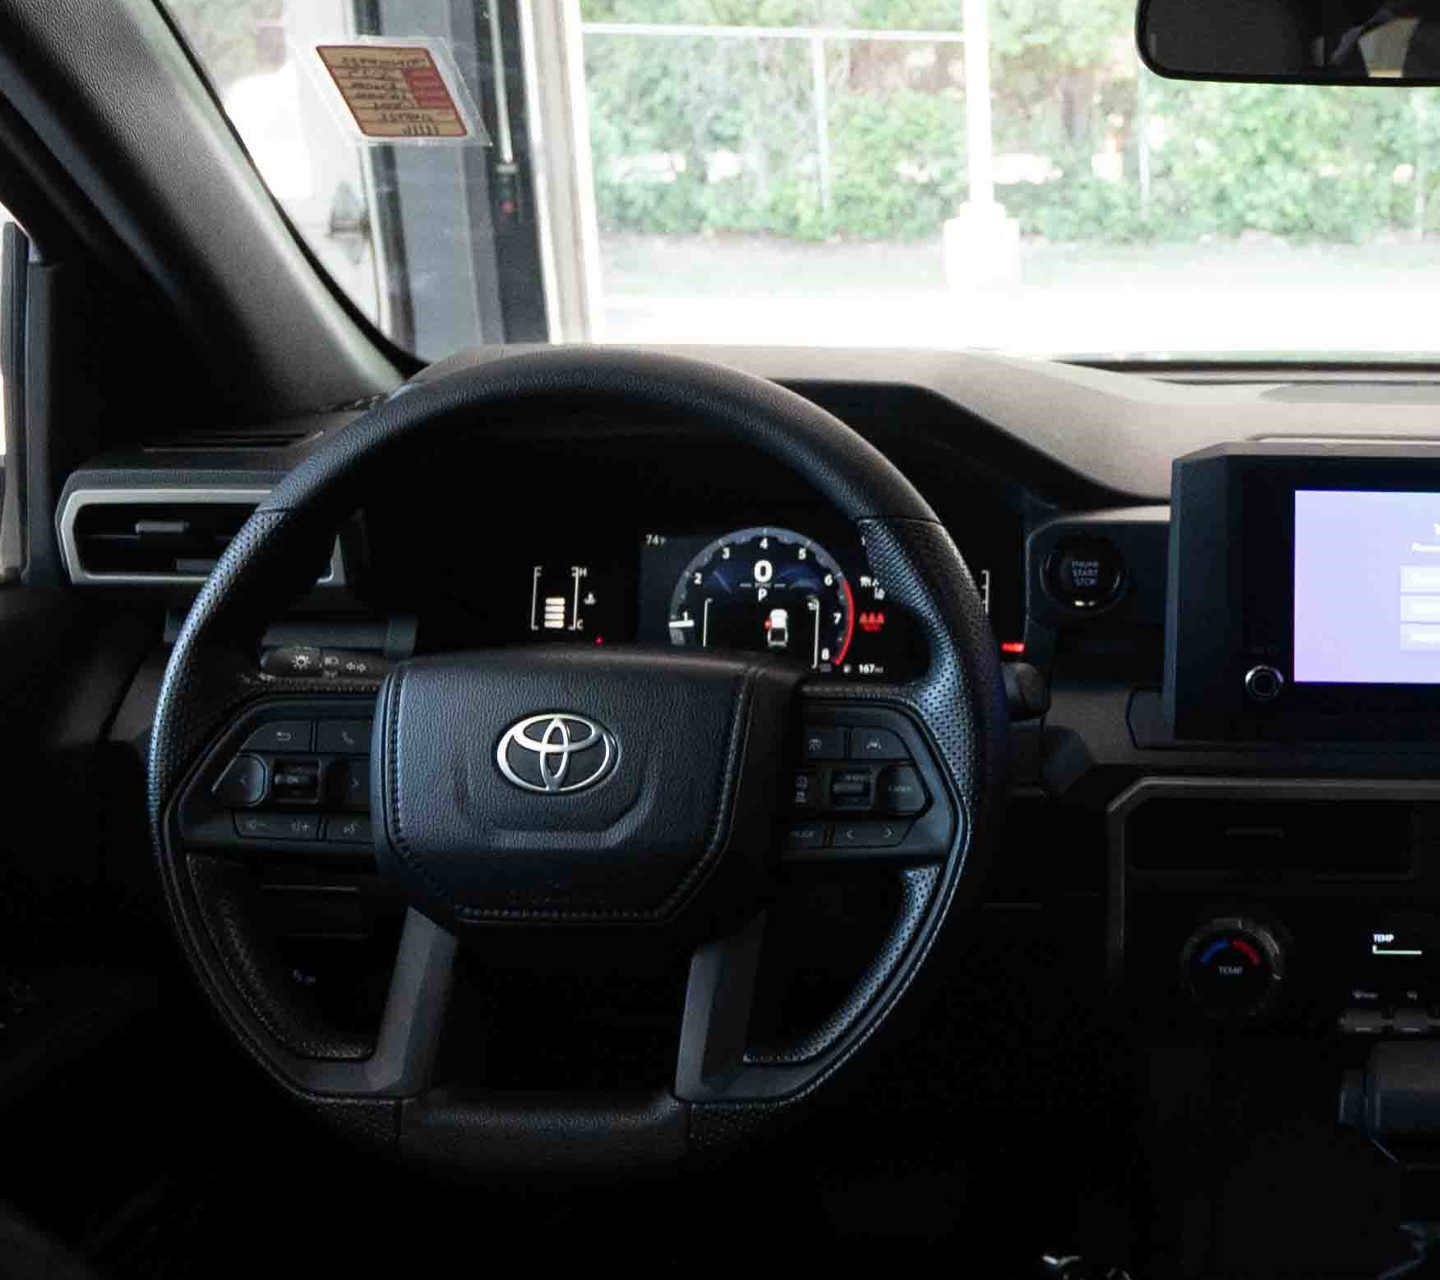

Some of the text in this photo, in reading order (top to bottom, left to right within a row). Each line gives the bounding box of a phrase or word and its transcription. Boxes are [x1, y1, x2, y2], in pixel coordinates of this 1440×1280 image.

[759, 537, 769, 550] 4
[722, 548, 730, 560] 3
[797, 548, 806, 560] 5
[753, 559, 773, 583] 0
[694, 573, 703, 586] 2
[824, 574, 833, 587] 6
[758, 587, 768, 602] P
[833, 612, 842, 625] 7
